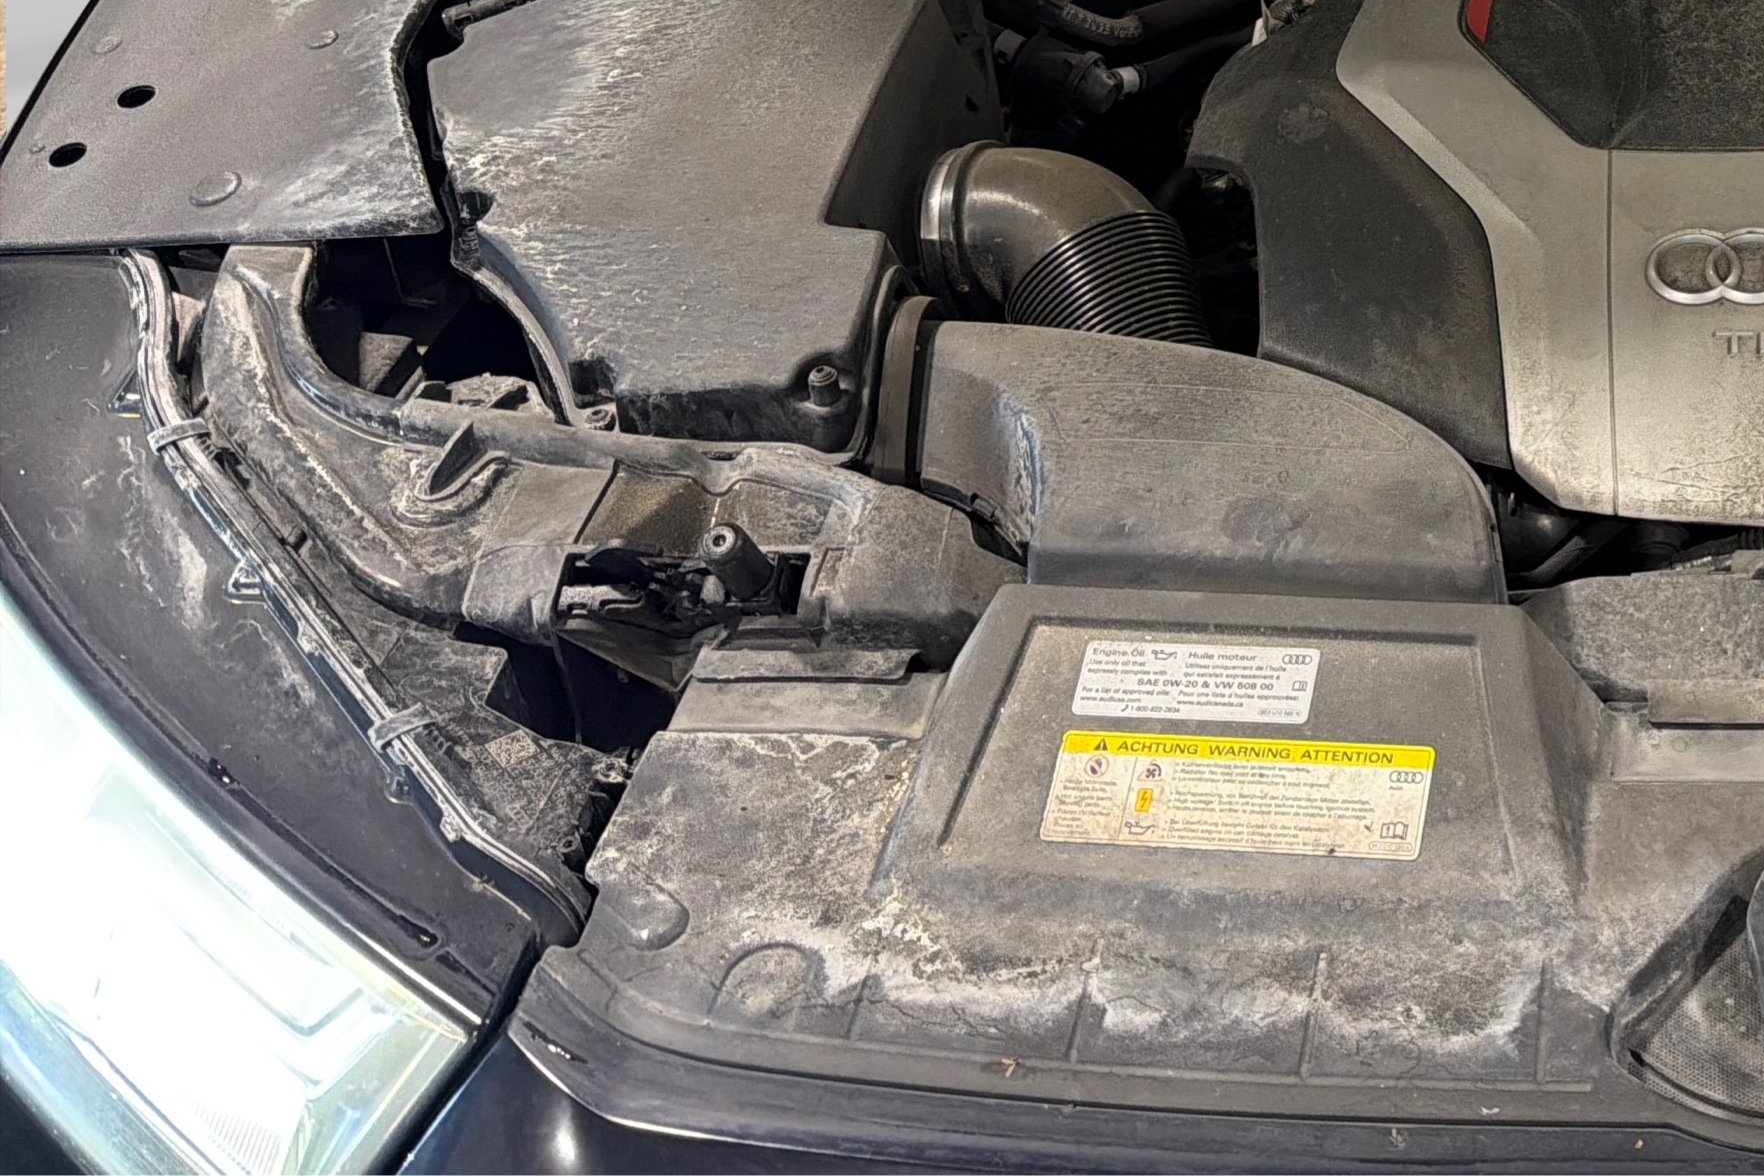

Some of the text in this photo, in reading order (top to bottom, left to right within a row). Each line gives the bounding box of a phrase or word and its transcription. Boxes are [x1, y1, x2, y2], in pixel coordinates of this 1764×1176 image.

[1093, 648, 1145, 657] Engine Oil
[1188, 652, 1257, 661] Huile moteur
[1212, 664, 1253, 672] uniquement
[1137, 678, 1274, 691] SAE 0W-20 & VW 508 00
[1122, 688, 1155, 696] approved
[1117, 741, 1394, 764] ACHTUNG WARNING ATTENTION
